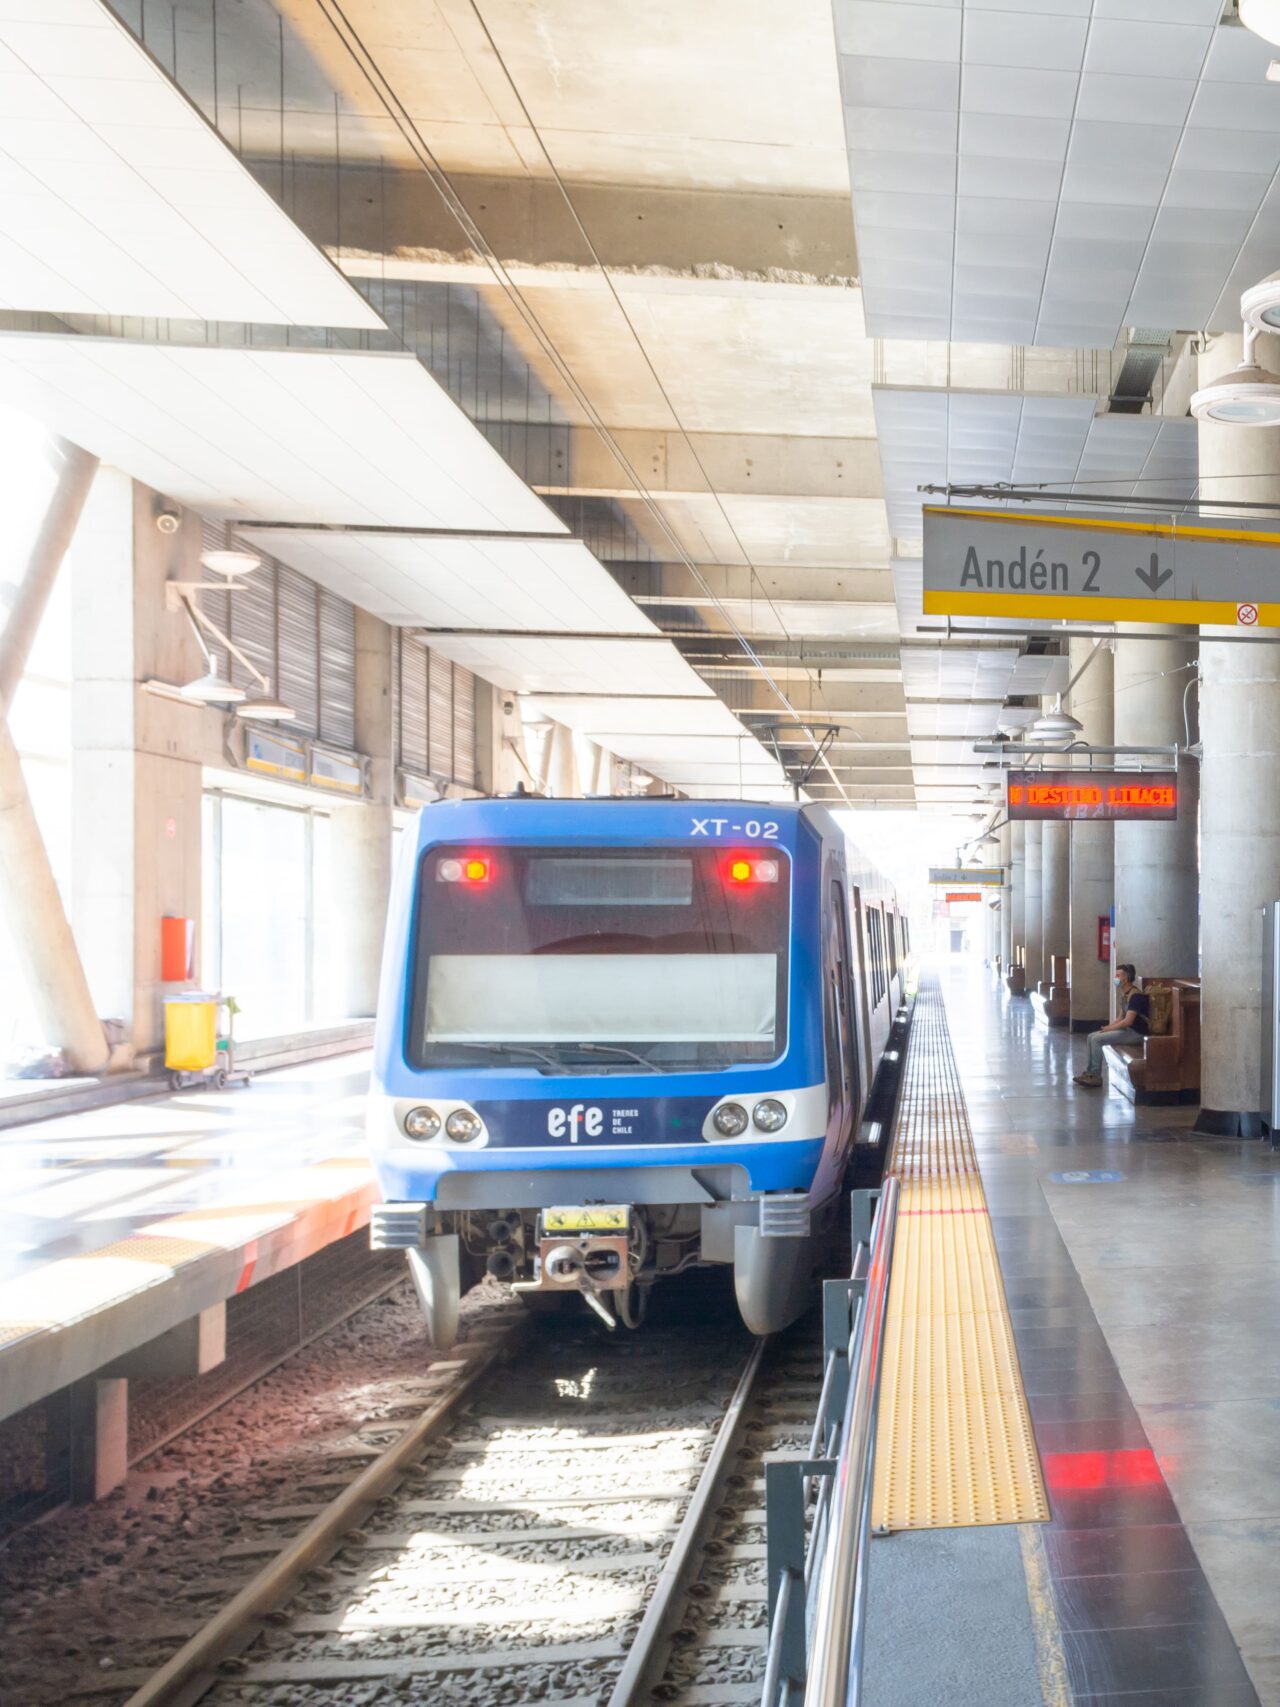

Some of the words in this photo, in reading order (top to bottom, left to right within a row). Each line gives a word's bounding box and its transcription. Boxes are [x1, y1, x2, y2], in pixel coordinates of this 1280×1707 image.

[960, 546, 1069, 591] Andén
[1082, 551, 1101, 592] 2
[690, 818, 779, 839] XT-02
[548, 1104, 603, 1143] efe
[612, 1118, 622, 1126] DE
[612, 1126, 632, 1134] CHILE
